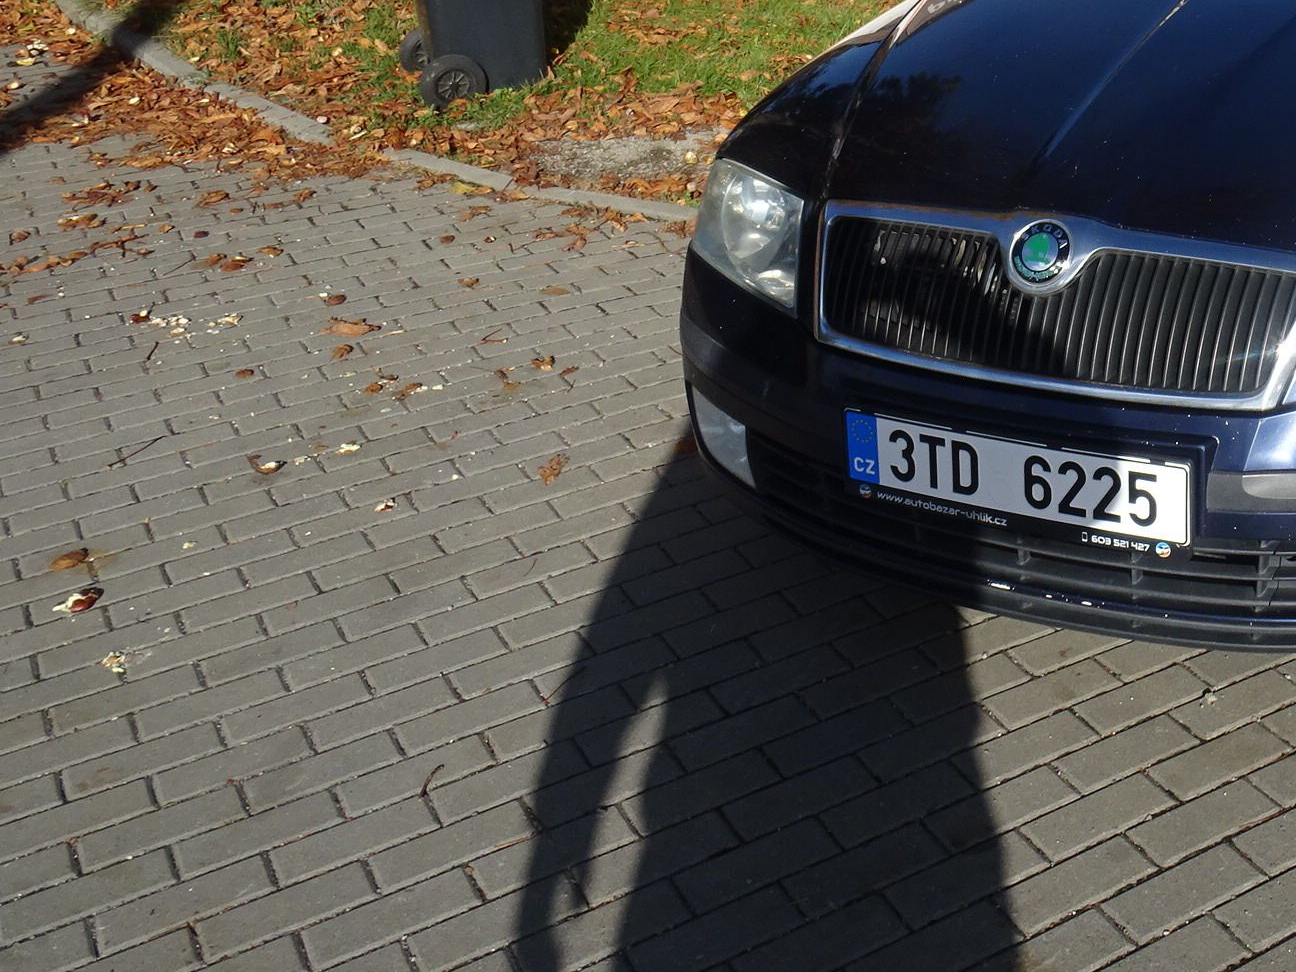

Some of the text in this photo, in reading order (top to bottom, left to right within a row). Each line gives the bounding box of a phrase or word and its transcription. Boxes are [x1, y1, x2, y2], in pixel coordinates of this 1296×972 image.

[853, 457, 876, 476] CZ
[888, 429, 1158, 528] 3TD 6225
[876, 490, 1008, 527] www.autobazar-uhlik.cz
[1091, 535, 1150, 552] 603 521 427
